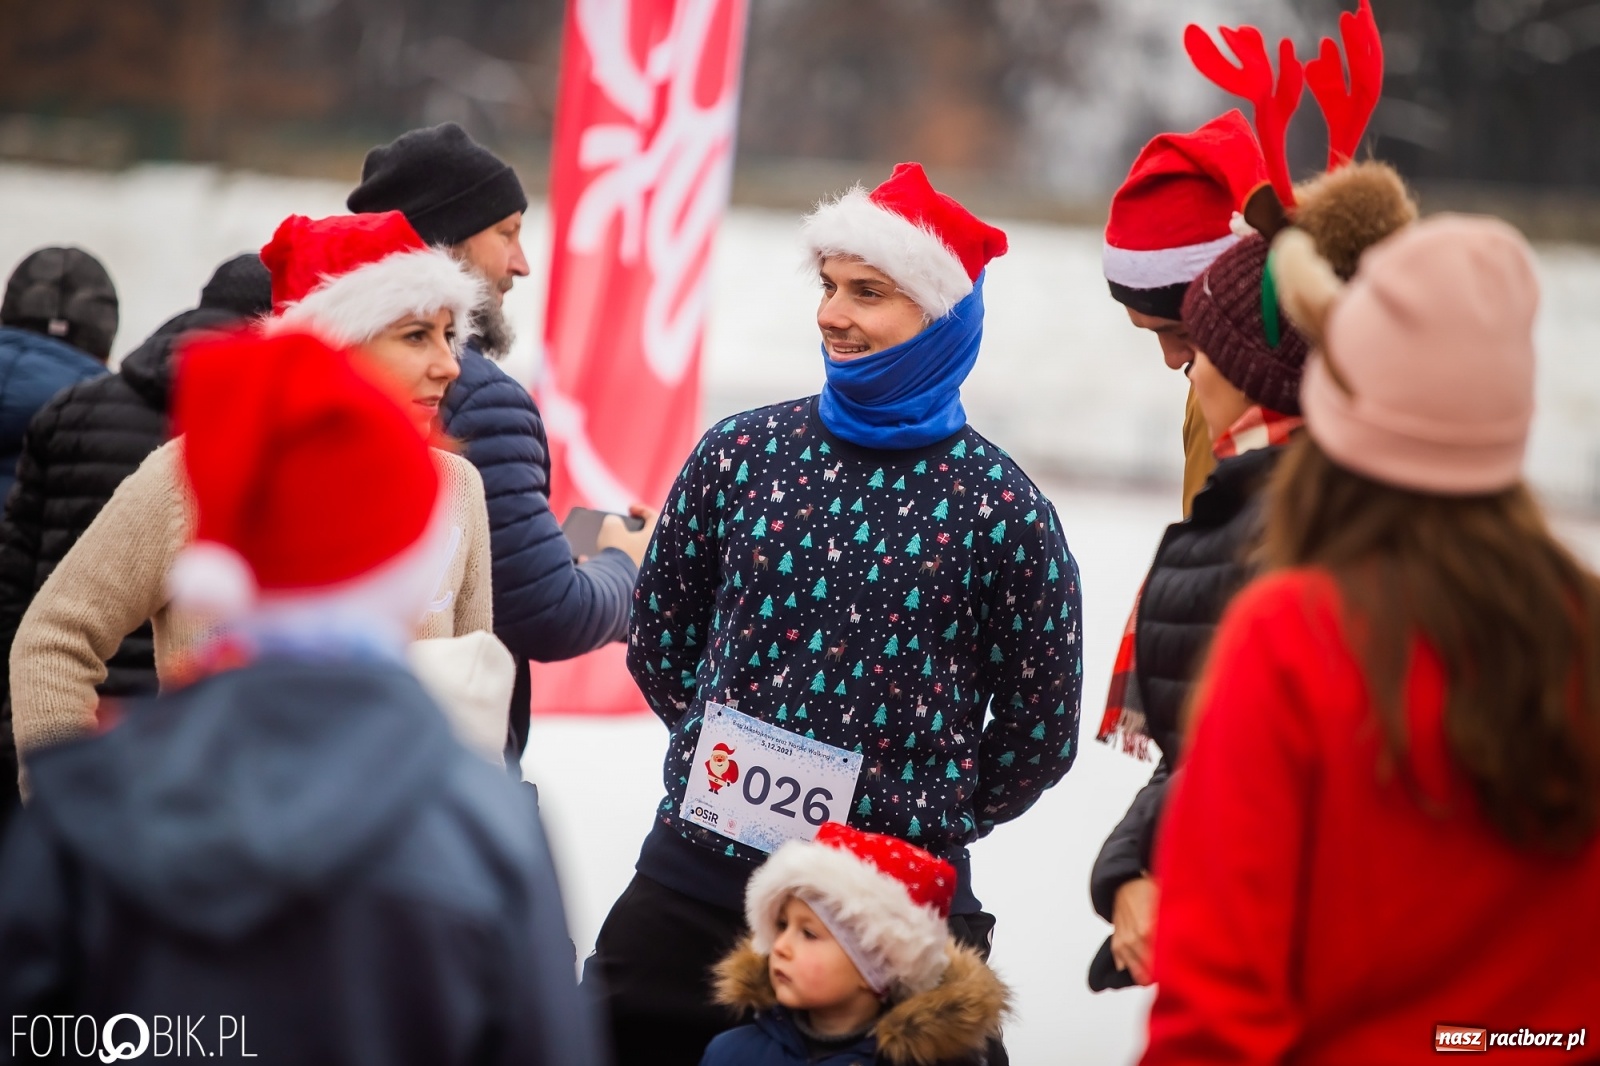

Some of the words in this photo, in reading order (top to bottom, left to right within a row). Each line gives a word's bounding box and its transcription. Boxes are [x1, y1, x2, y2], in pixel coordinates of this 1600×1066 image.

[761, 740, 793, 757] 5.12.2021
[808, 748, 831, 761] Walking
[742, 765, 834, 826] 026
